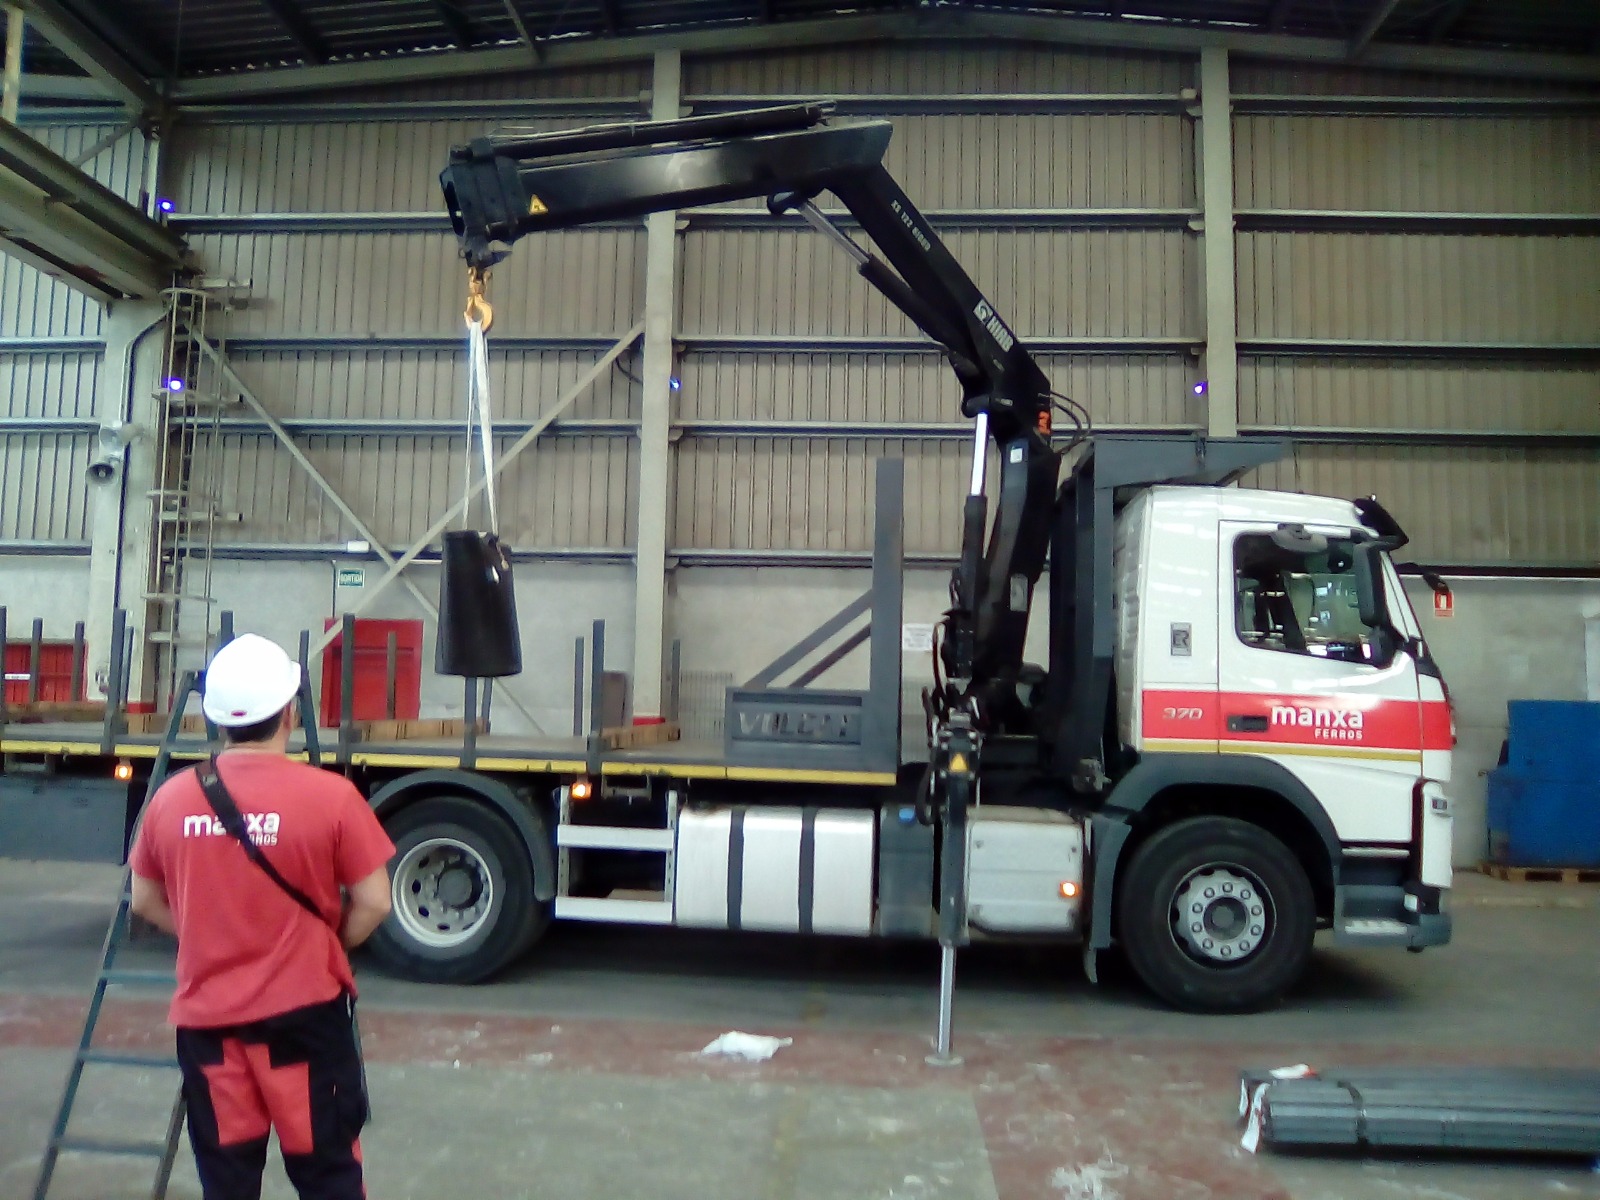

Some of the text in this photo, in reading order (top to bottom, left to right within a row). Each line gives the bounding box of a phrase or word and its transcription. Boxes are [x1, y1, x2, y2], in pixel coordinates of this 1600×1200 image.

[901, 211, 914, 228] 122
[1163, 707, 1203, 720] 370
[1271, 705, 1363, 728] manxa
[1314, 727, 1363, 740] FERROS
[183, 812, 280, 838] maxa
